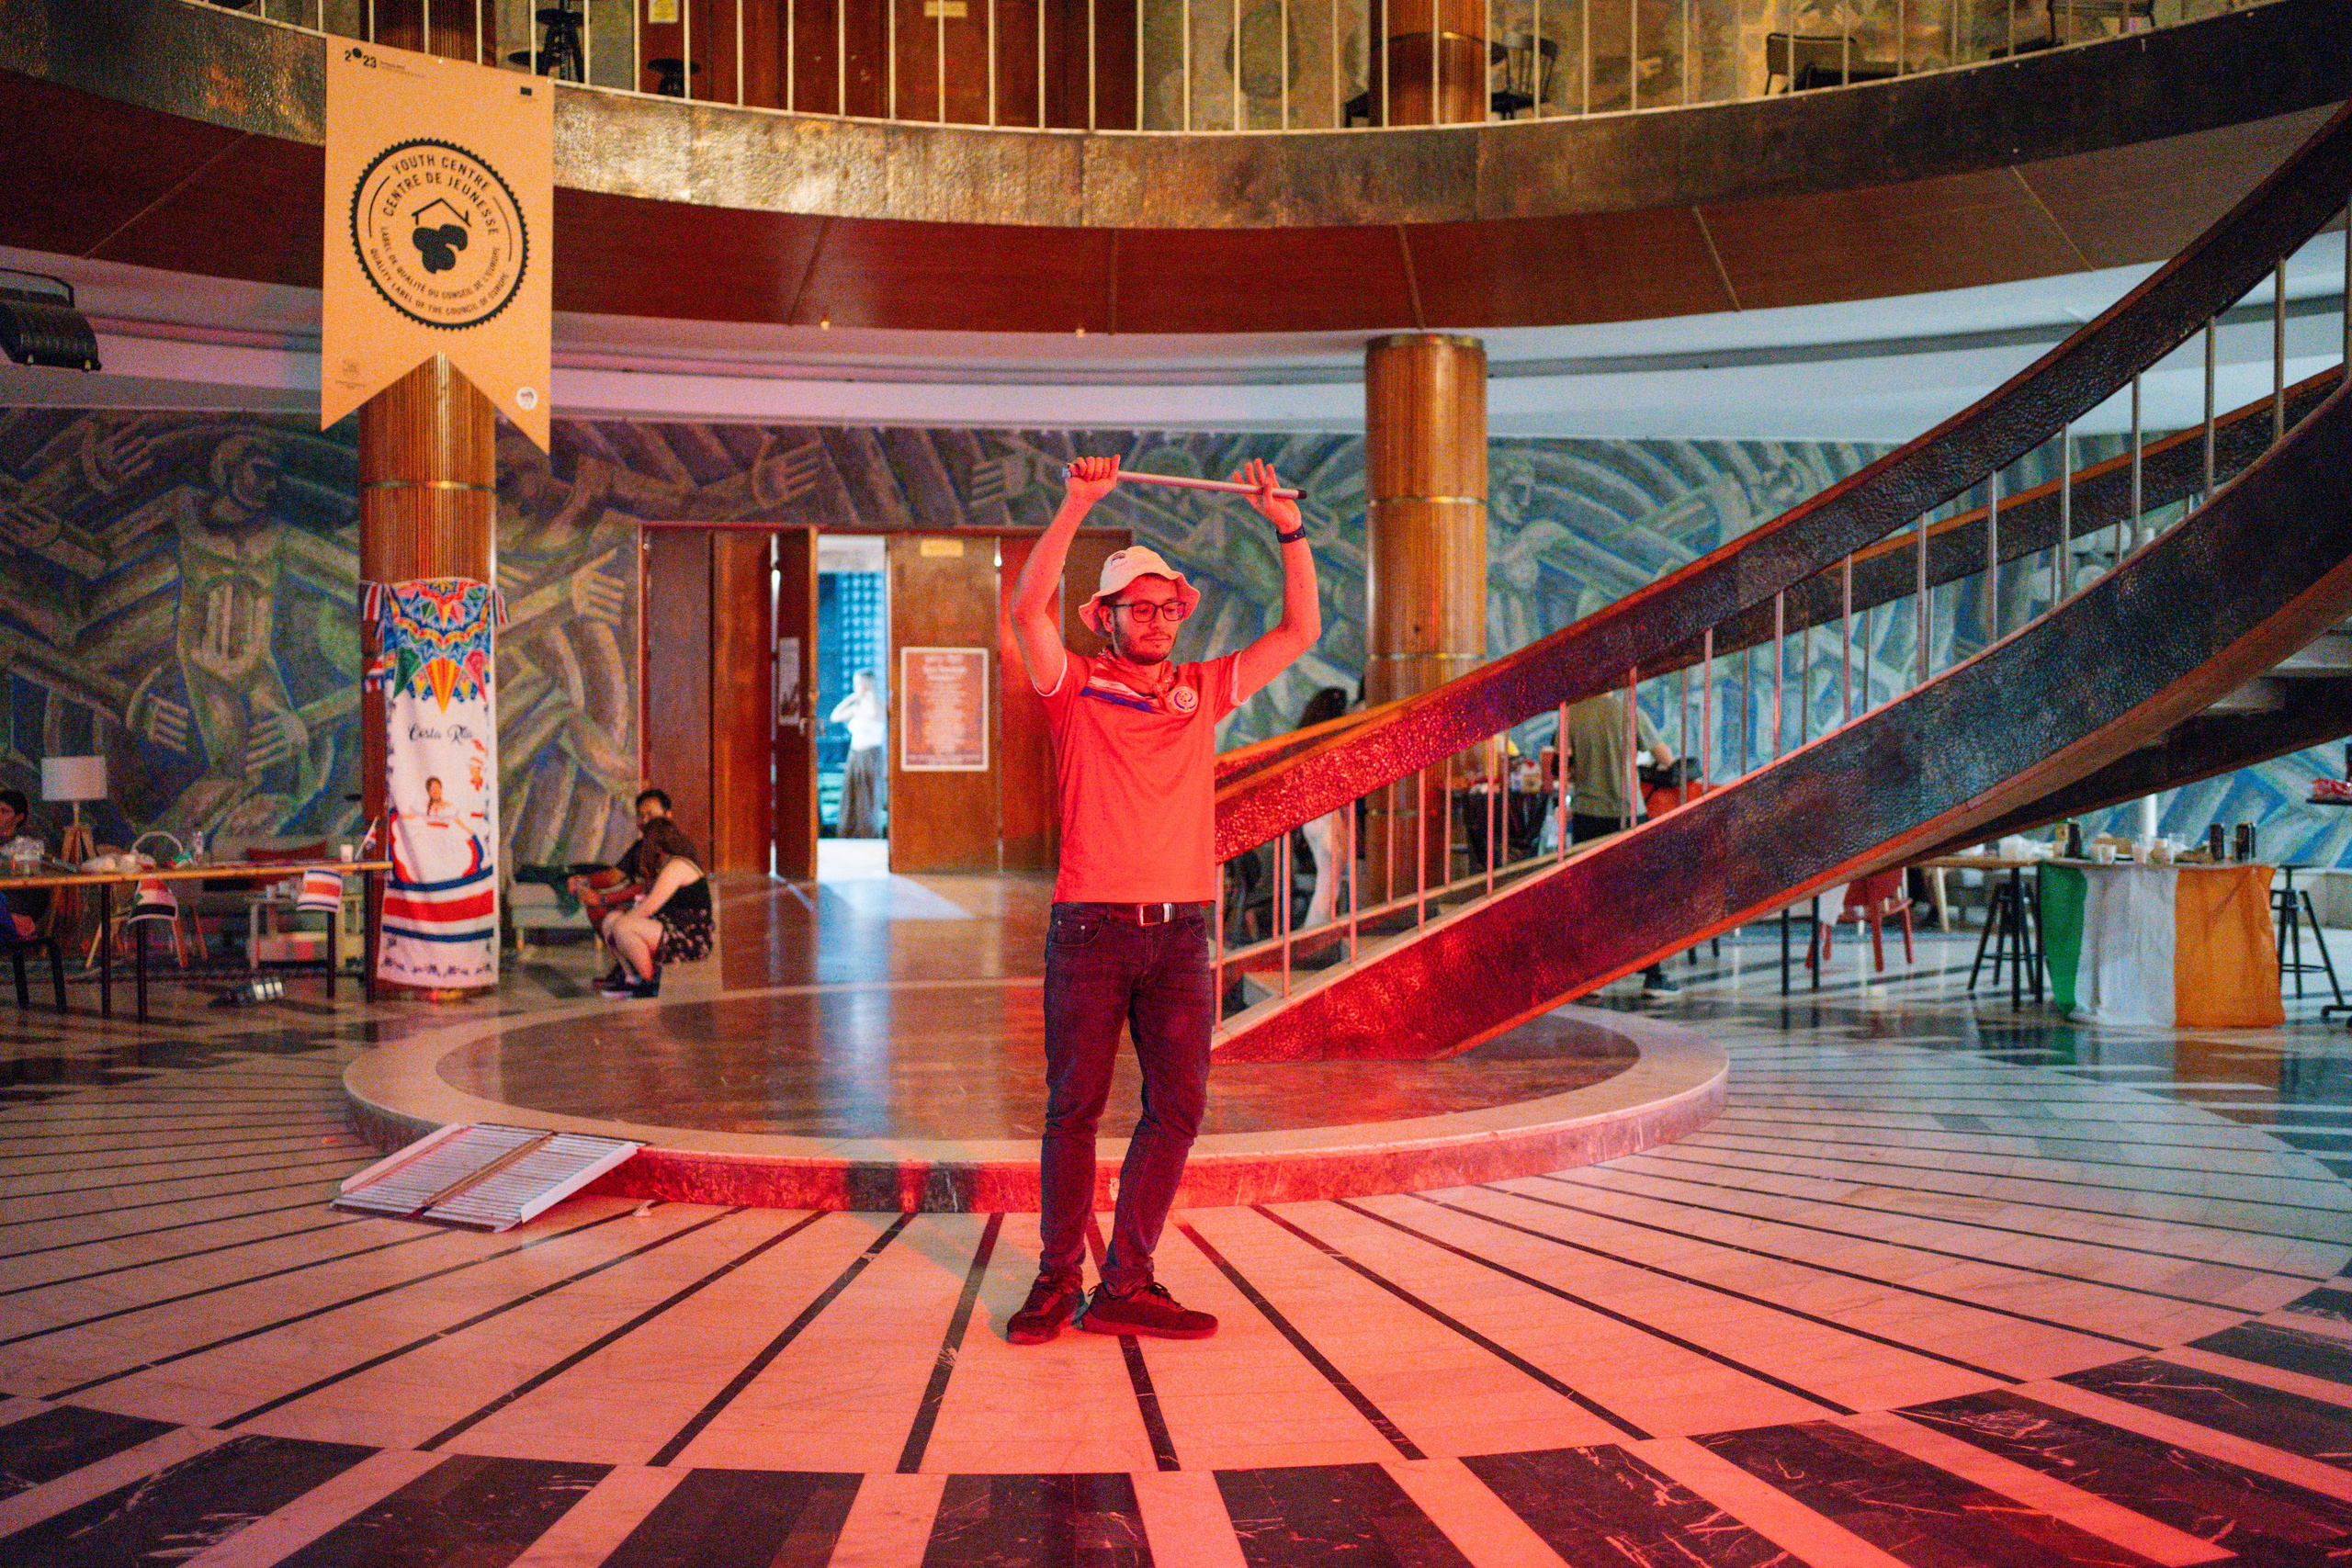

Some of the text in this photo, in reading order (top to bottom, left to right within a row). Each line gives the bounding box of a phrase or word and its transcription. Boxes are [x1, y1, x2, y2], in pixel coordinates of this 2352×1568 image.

[392, 154, 492, 192] YOUTH CENTRE
[383, 172, 499, 236] CENTRE DE JEUNESSE
[370, 247, 392, 281] QUALITY
[391, 282, 413, 303] LABEL
[407, 722, 442, 742] Costa
